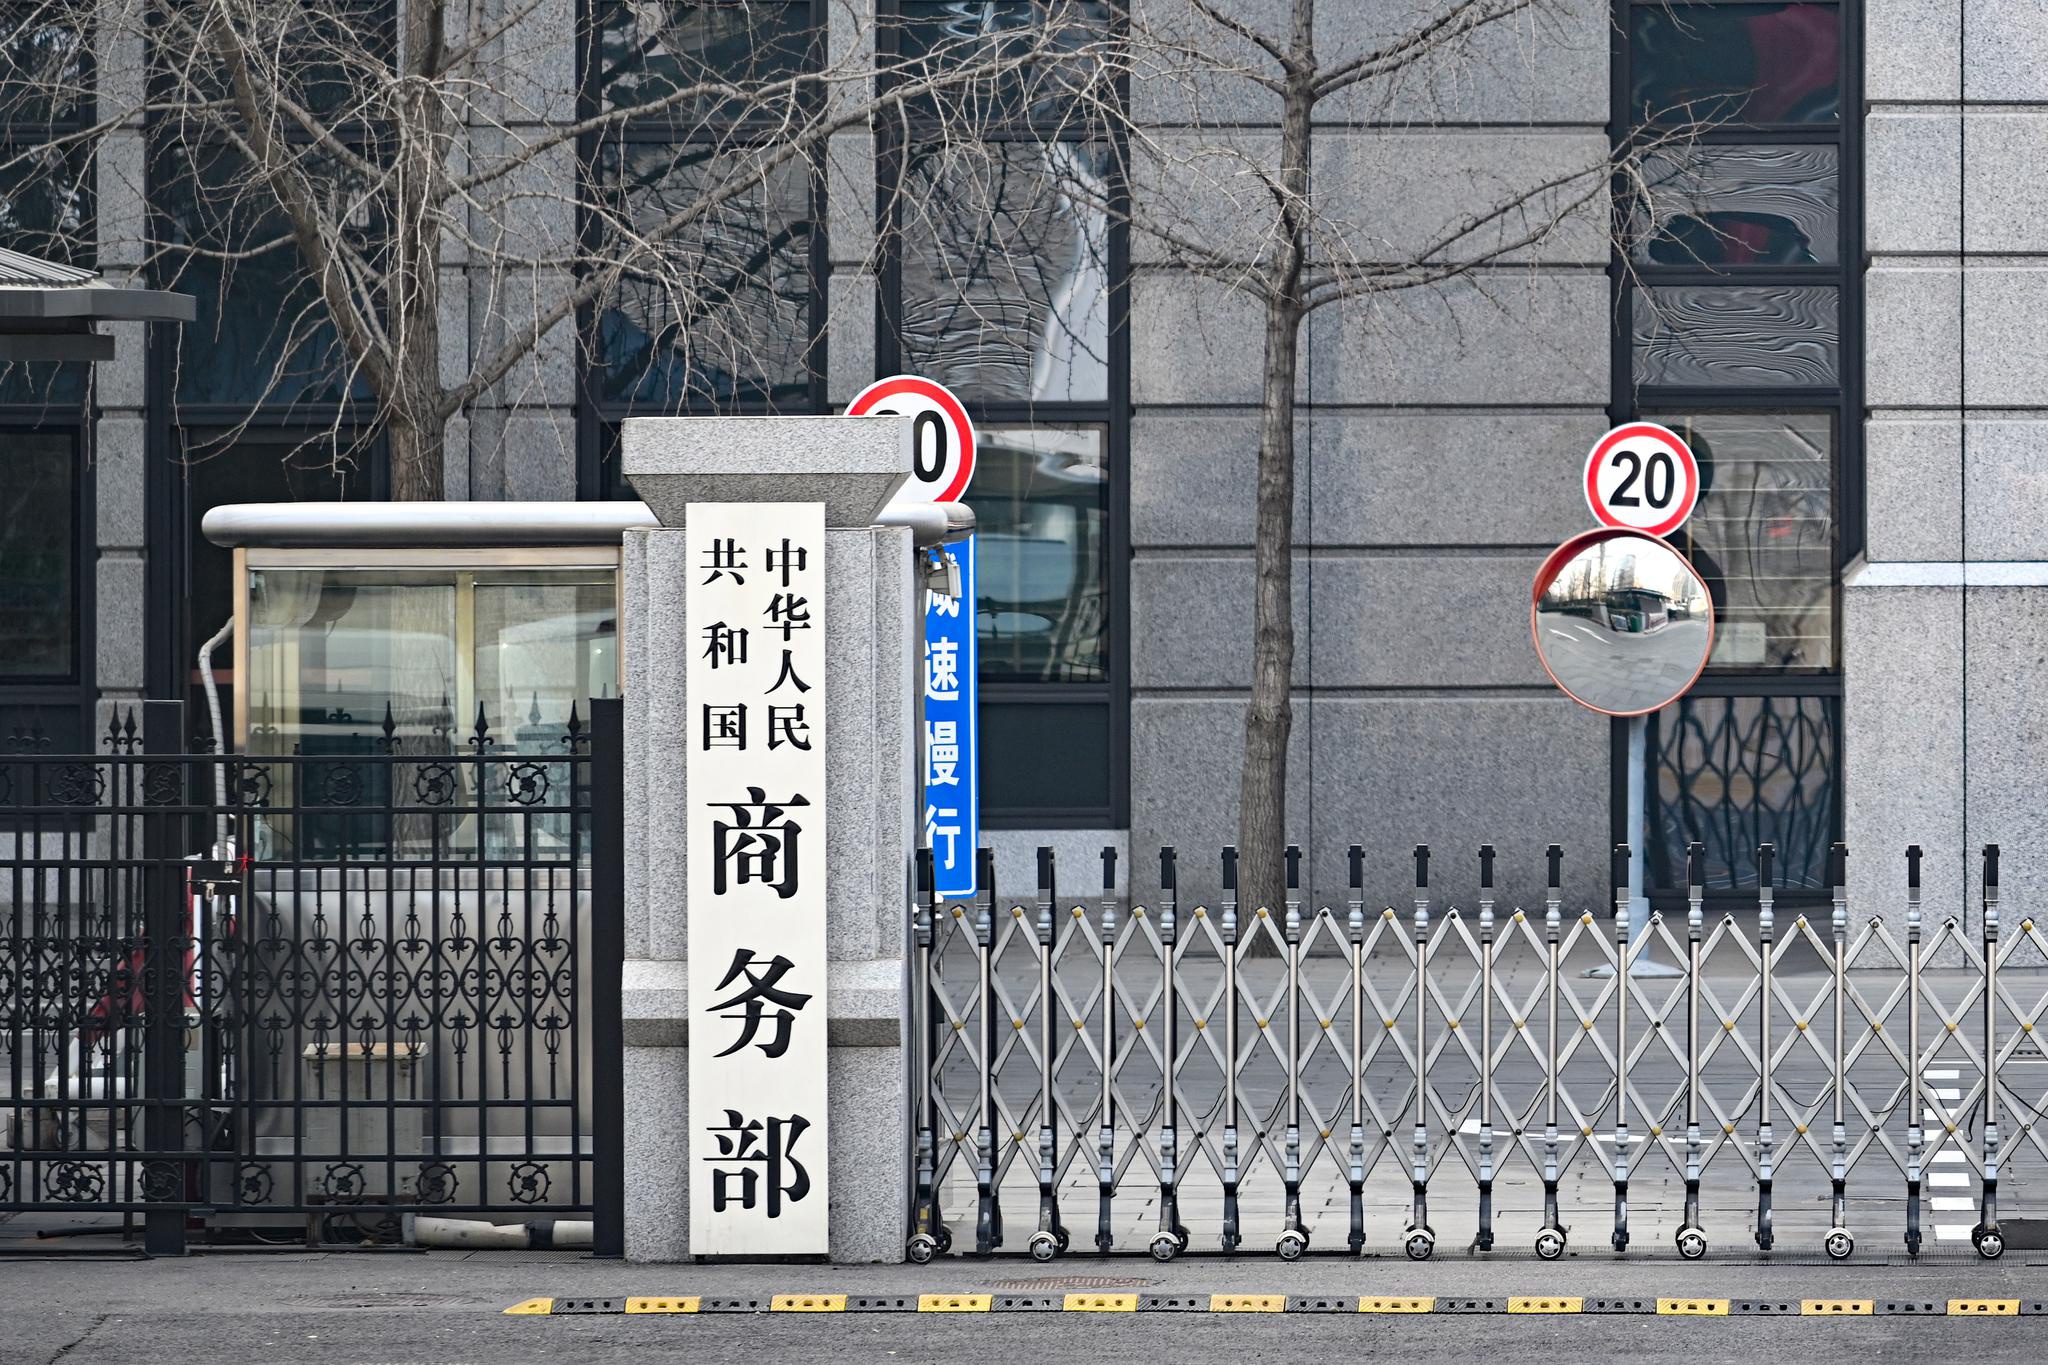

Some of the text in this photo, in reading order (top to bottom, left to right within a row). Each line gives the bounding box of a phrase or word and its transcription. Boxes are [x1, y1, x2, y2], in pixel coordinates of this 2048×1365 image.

[875, 409, 947, 483] 0
[1609, 450, 1675, 509] 20
[701, 538, 749, 751] 共和国
[763, 538, 812, 751] 中华人民
[703, 786, 812, 1219] 商务部
